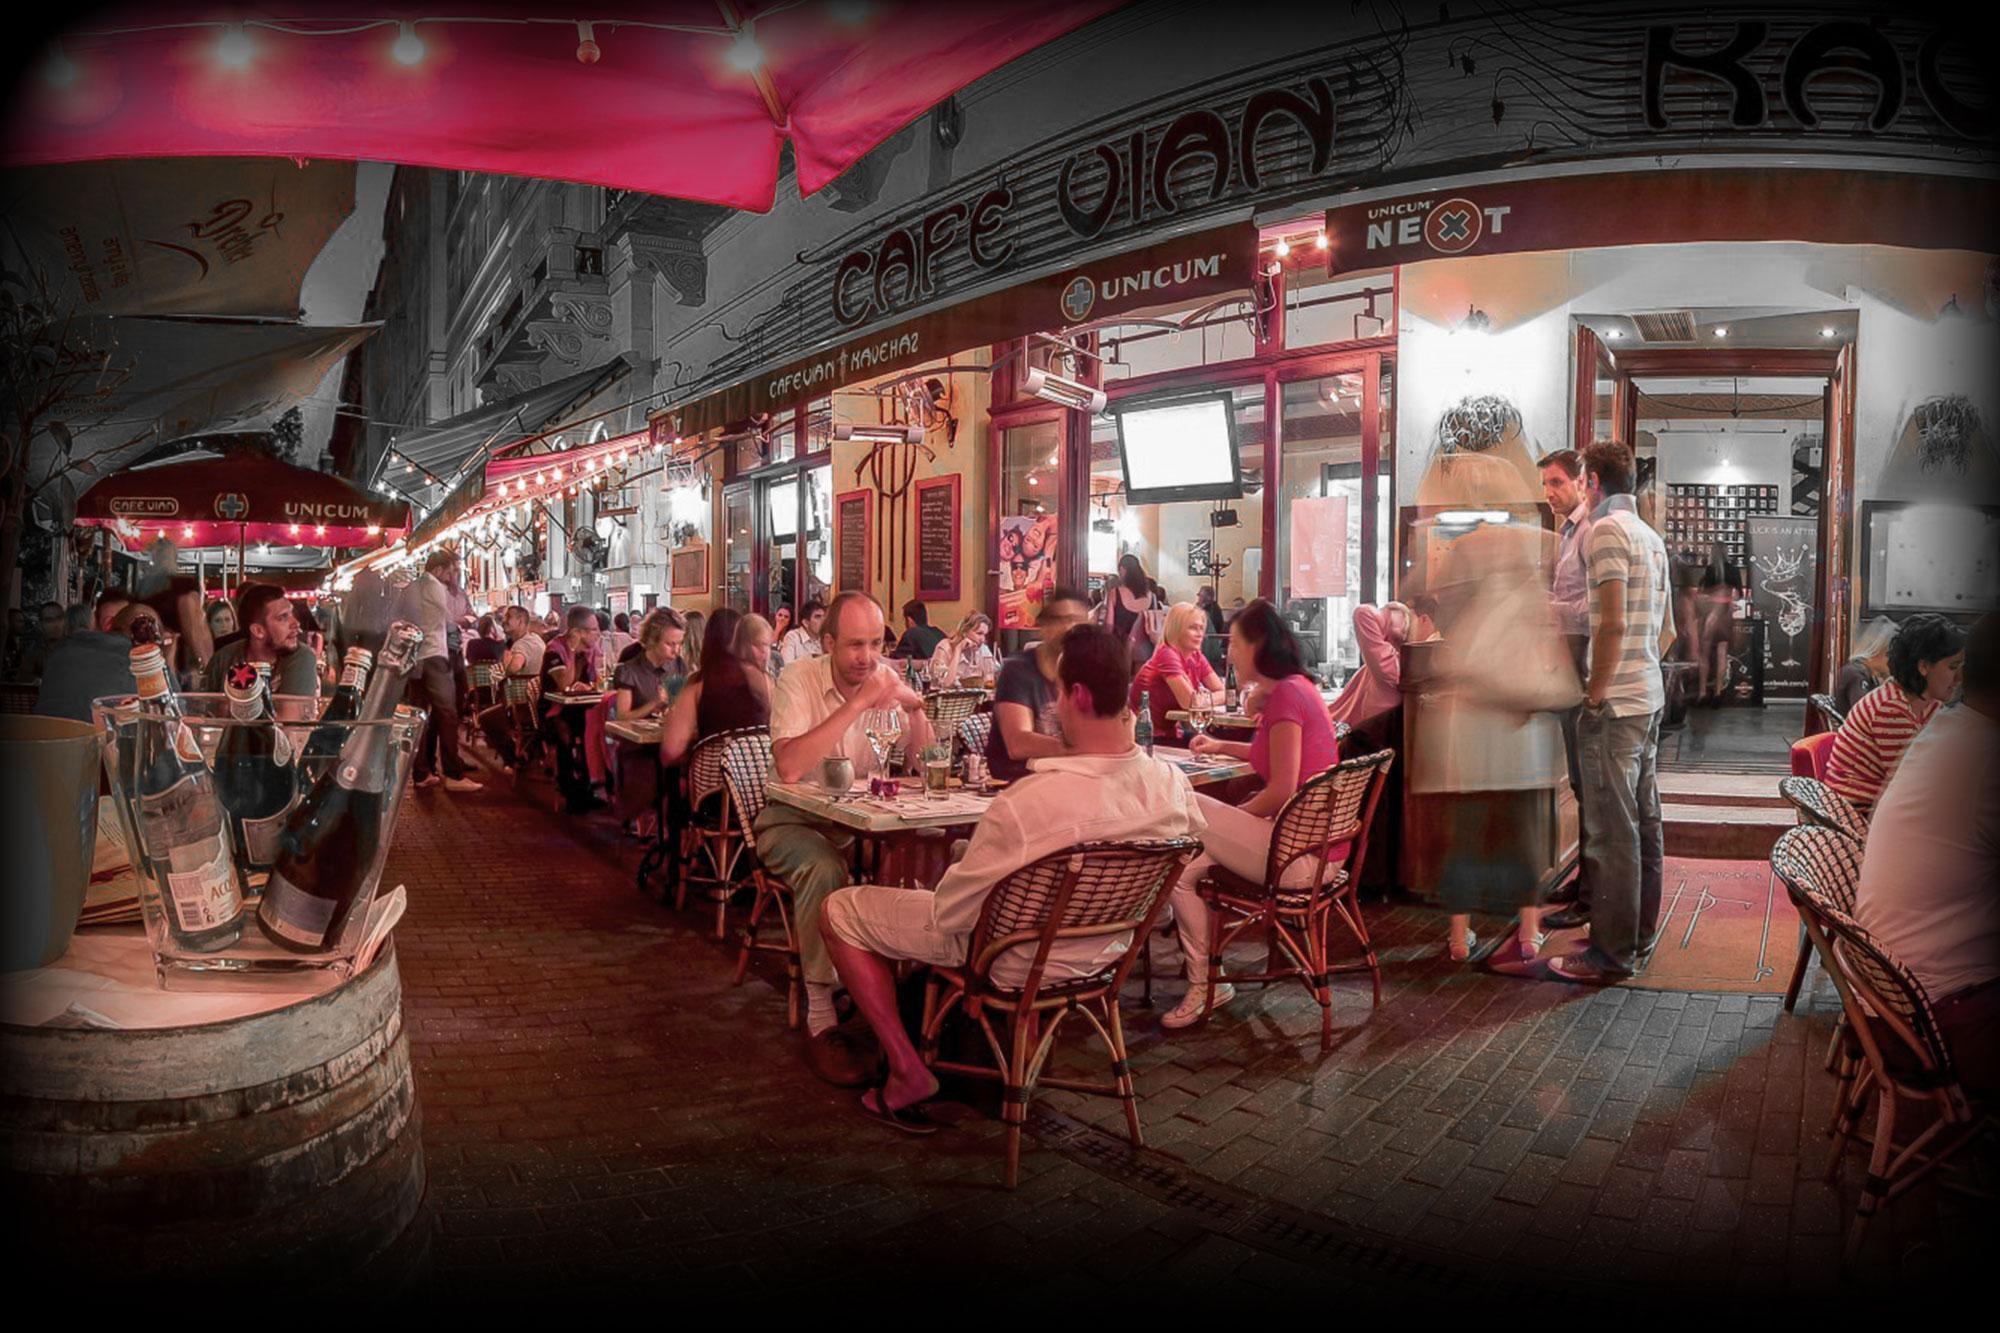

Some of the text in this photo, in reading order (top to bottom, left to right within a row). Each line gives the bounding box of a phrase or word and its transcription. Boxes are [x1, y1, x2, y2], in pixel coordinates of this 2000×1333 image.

[1057, 78, 1337, 240] VIAN
[1366, 199, 1511, 253] NEXT
[1368, 201, 1430, 219] UNICUM
[1102, 253, 1220, 300] UNICUM
[284, 502, 369, 519] UNICUM
